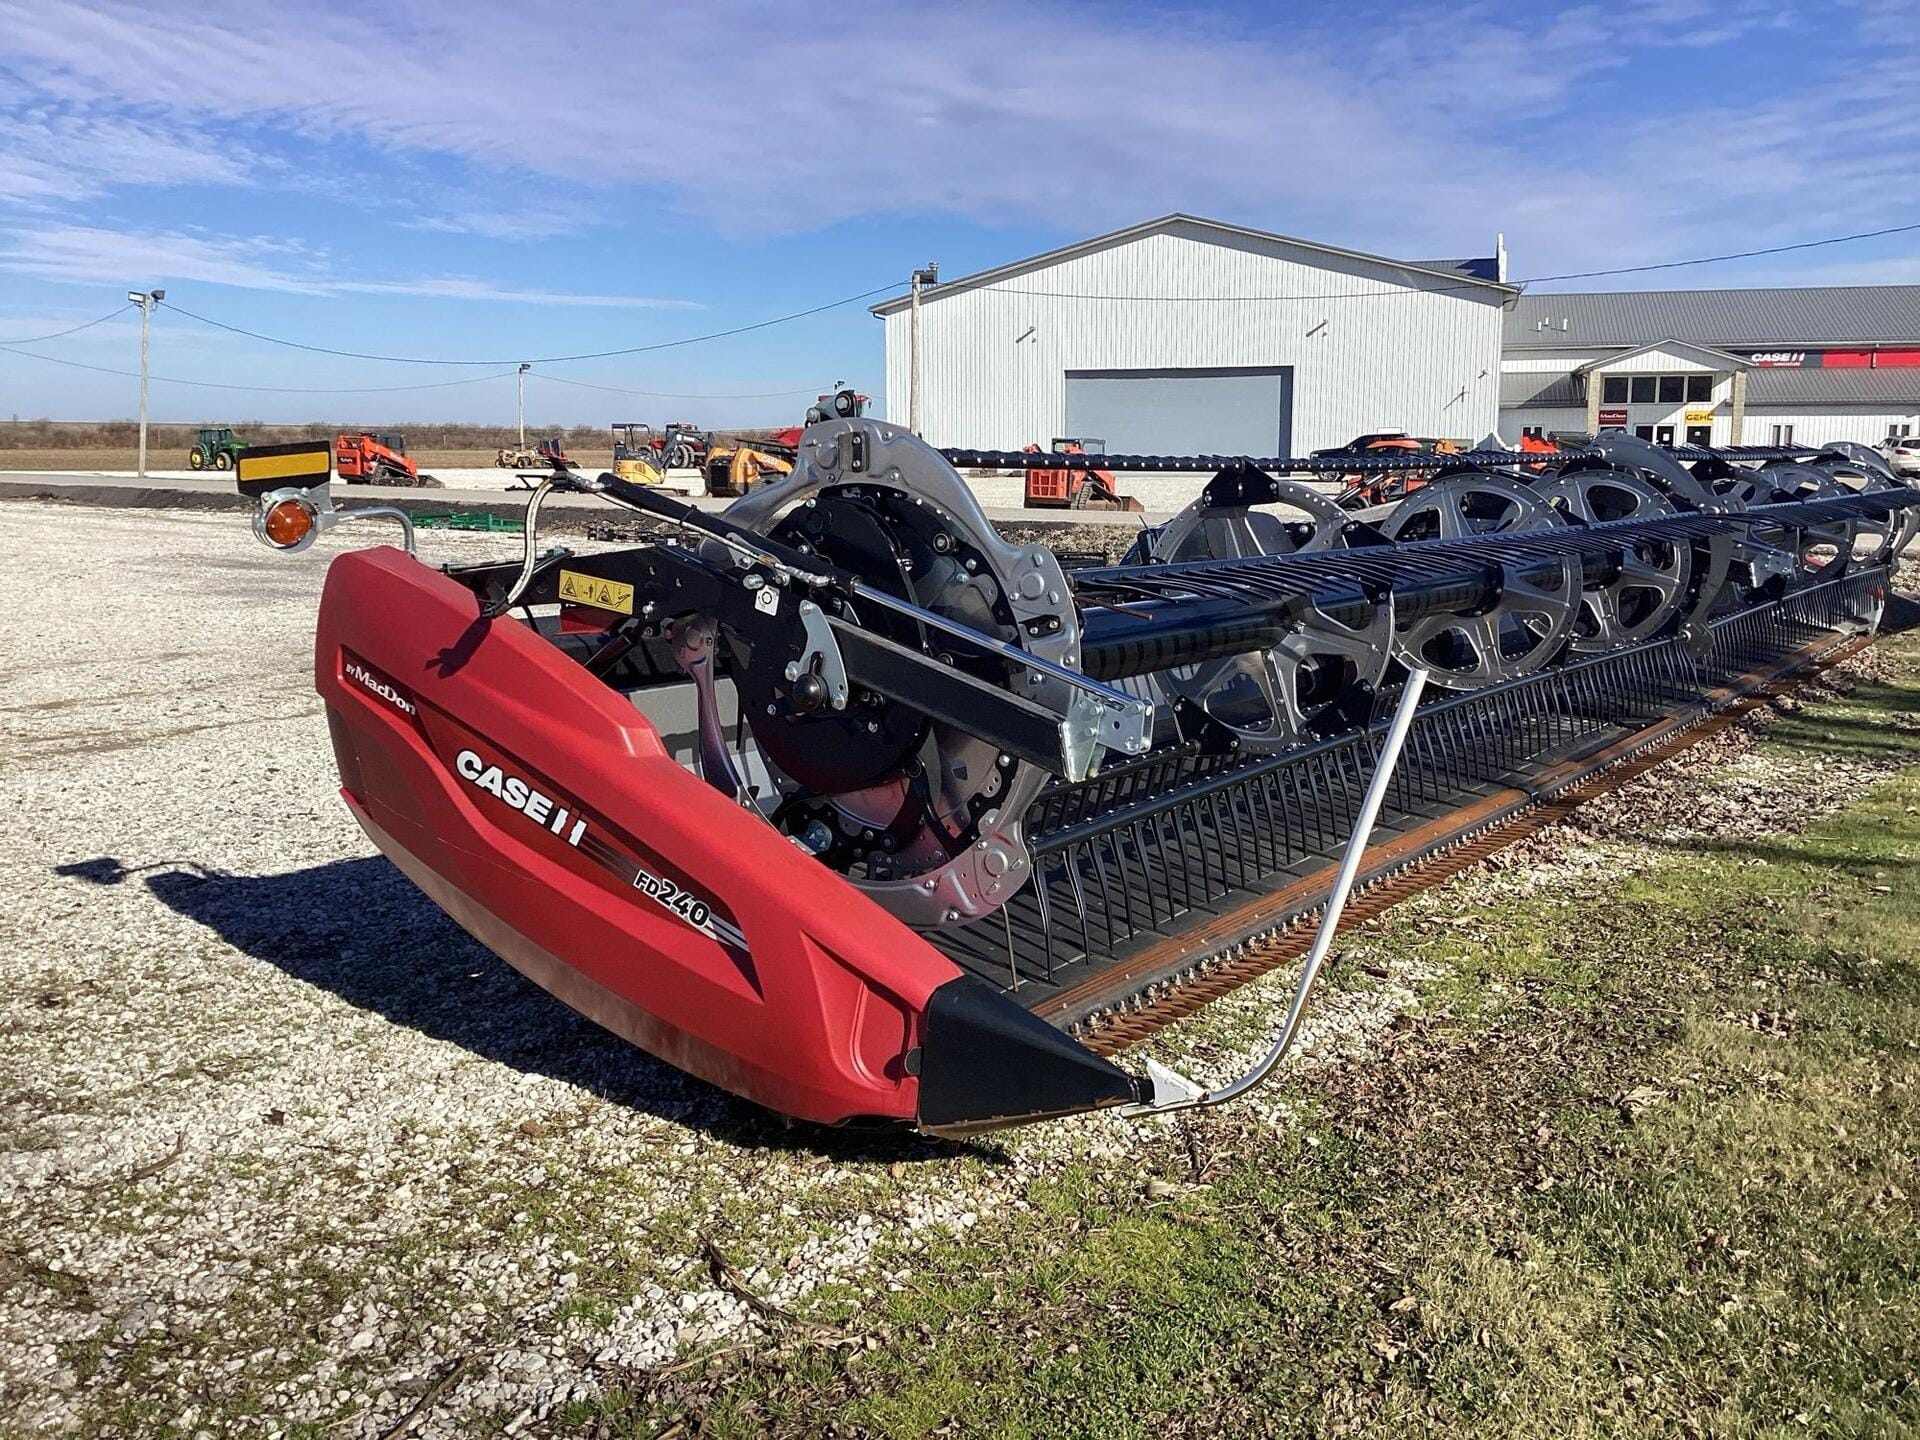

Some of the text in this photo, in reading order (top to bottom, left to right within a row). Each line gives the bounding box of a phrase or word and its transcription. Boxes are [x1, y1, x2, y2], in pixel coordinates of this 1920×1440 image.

[1751, 352, 1791, 362] CASE
[345, 663, 417, 716] BY MacDon
[456, 750, 553, 825] CASE
[632, 869, 711, 928] FD240
